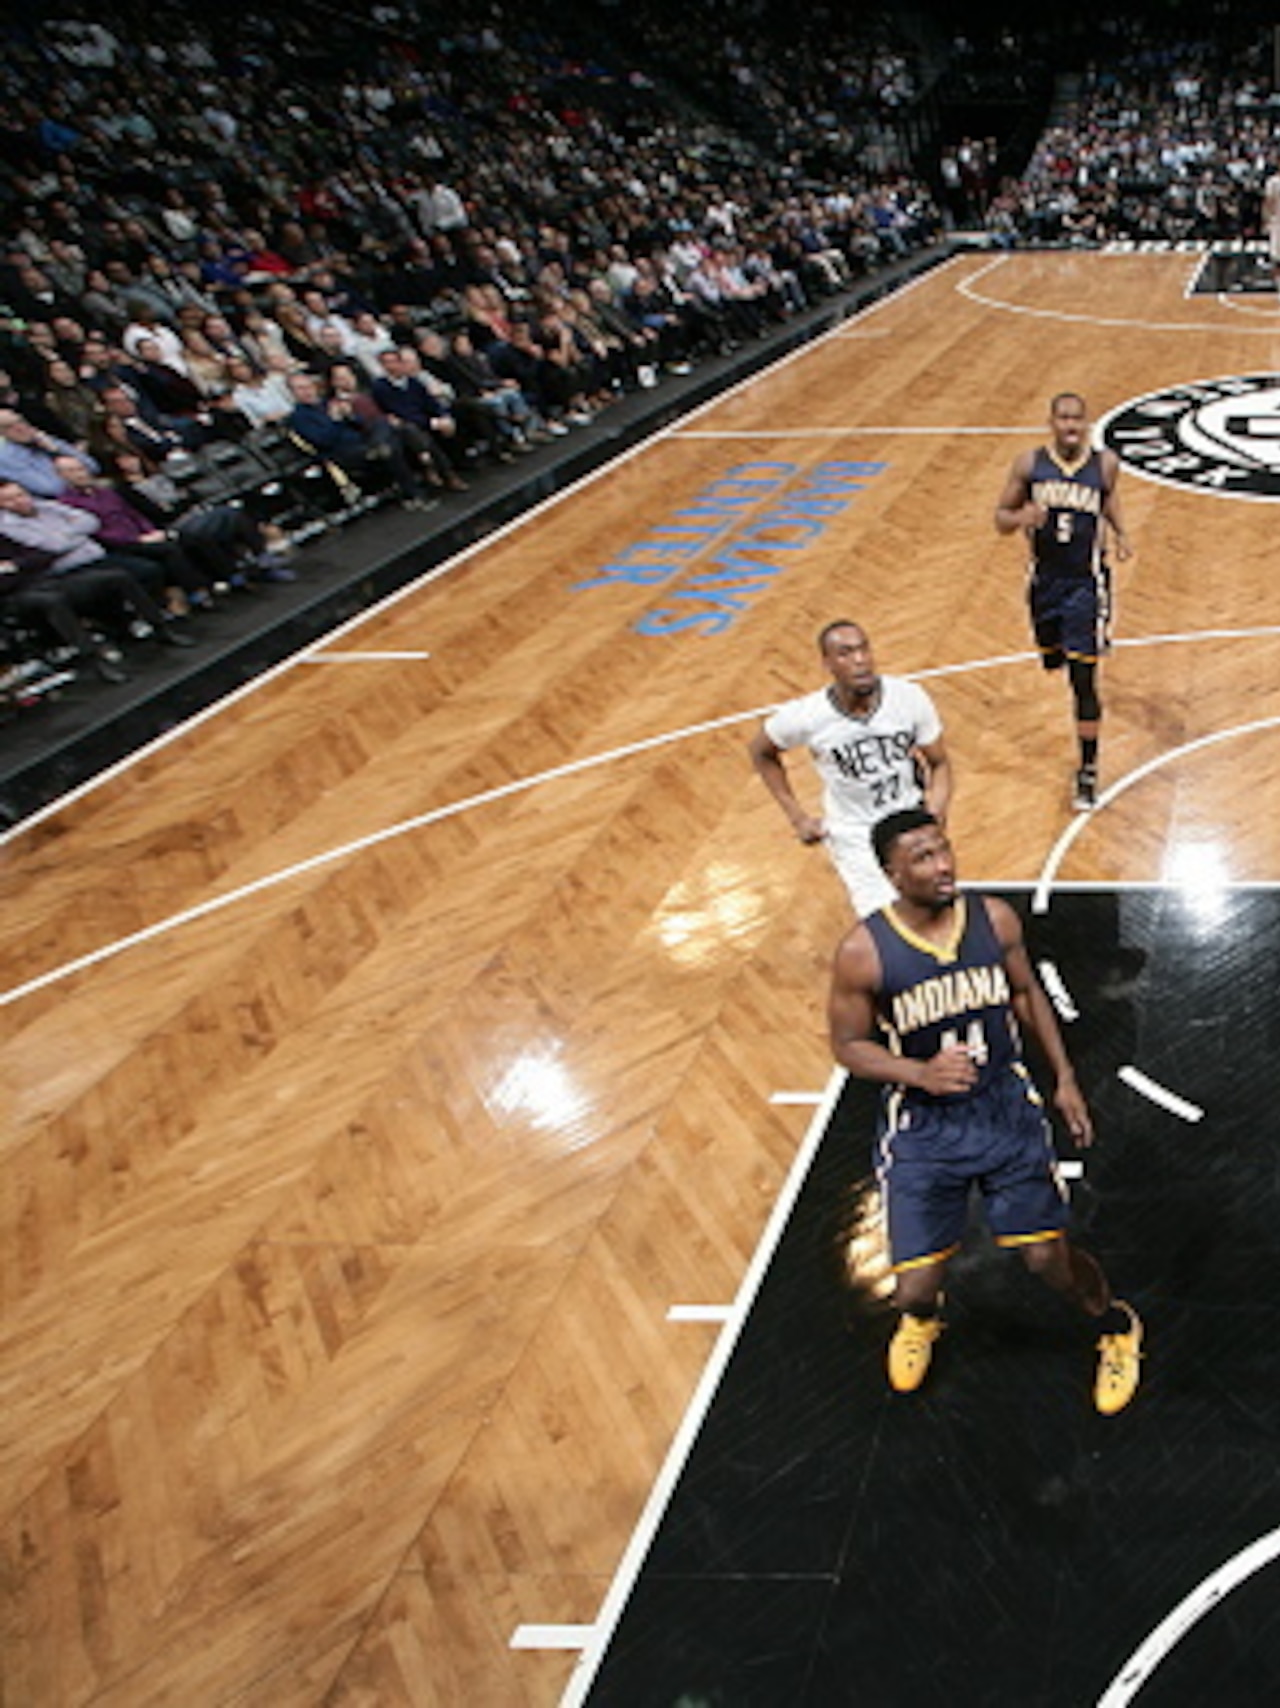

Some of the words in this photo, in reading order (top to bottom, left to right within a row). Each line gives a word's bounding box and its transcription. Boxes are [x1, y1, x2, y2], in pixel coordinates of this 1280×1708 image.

[566, 460, 800, 592] CENTER
[634, 460, 889, 637] BARCLAYS
[1057, 512, 1074, 543] 5
[831, 731, 909, 779] NETS
[892, 963, 1010, 1036] INDIANA
